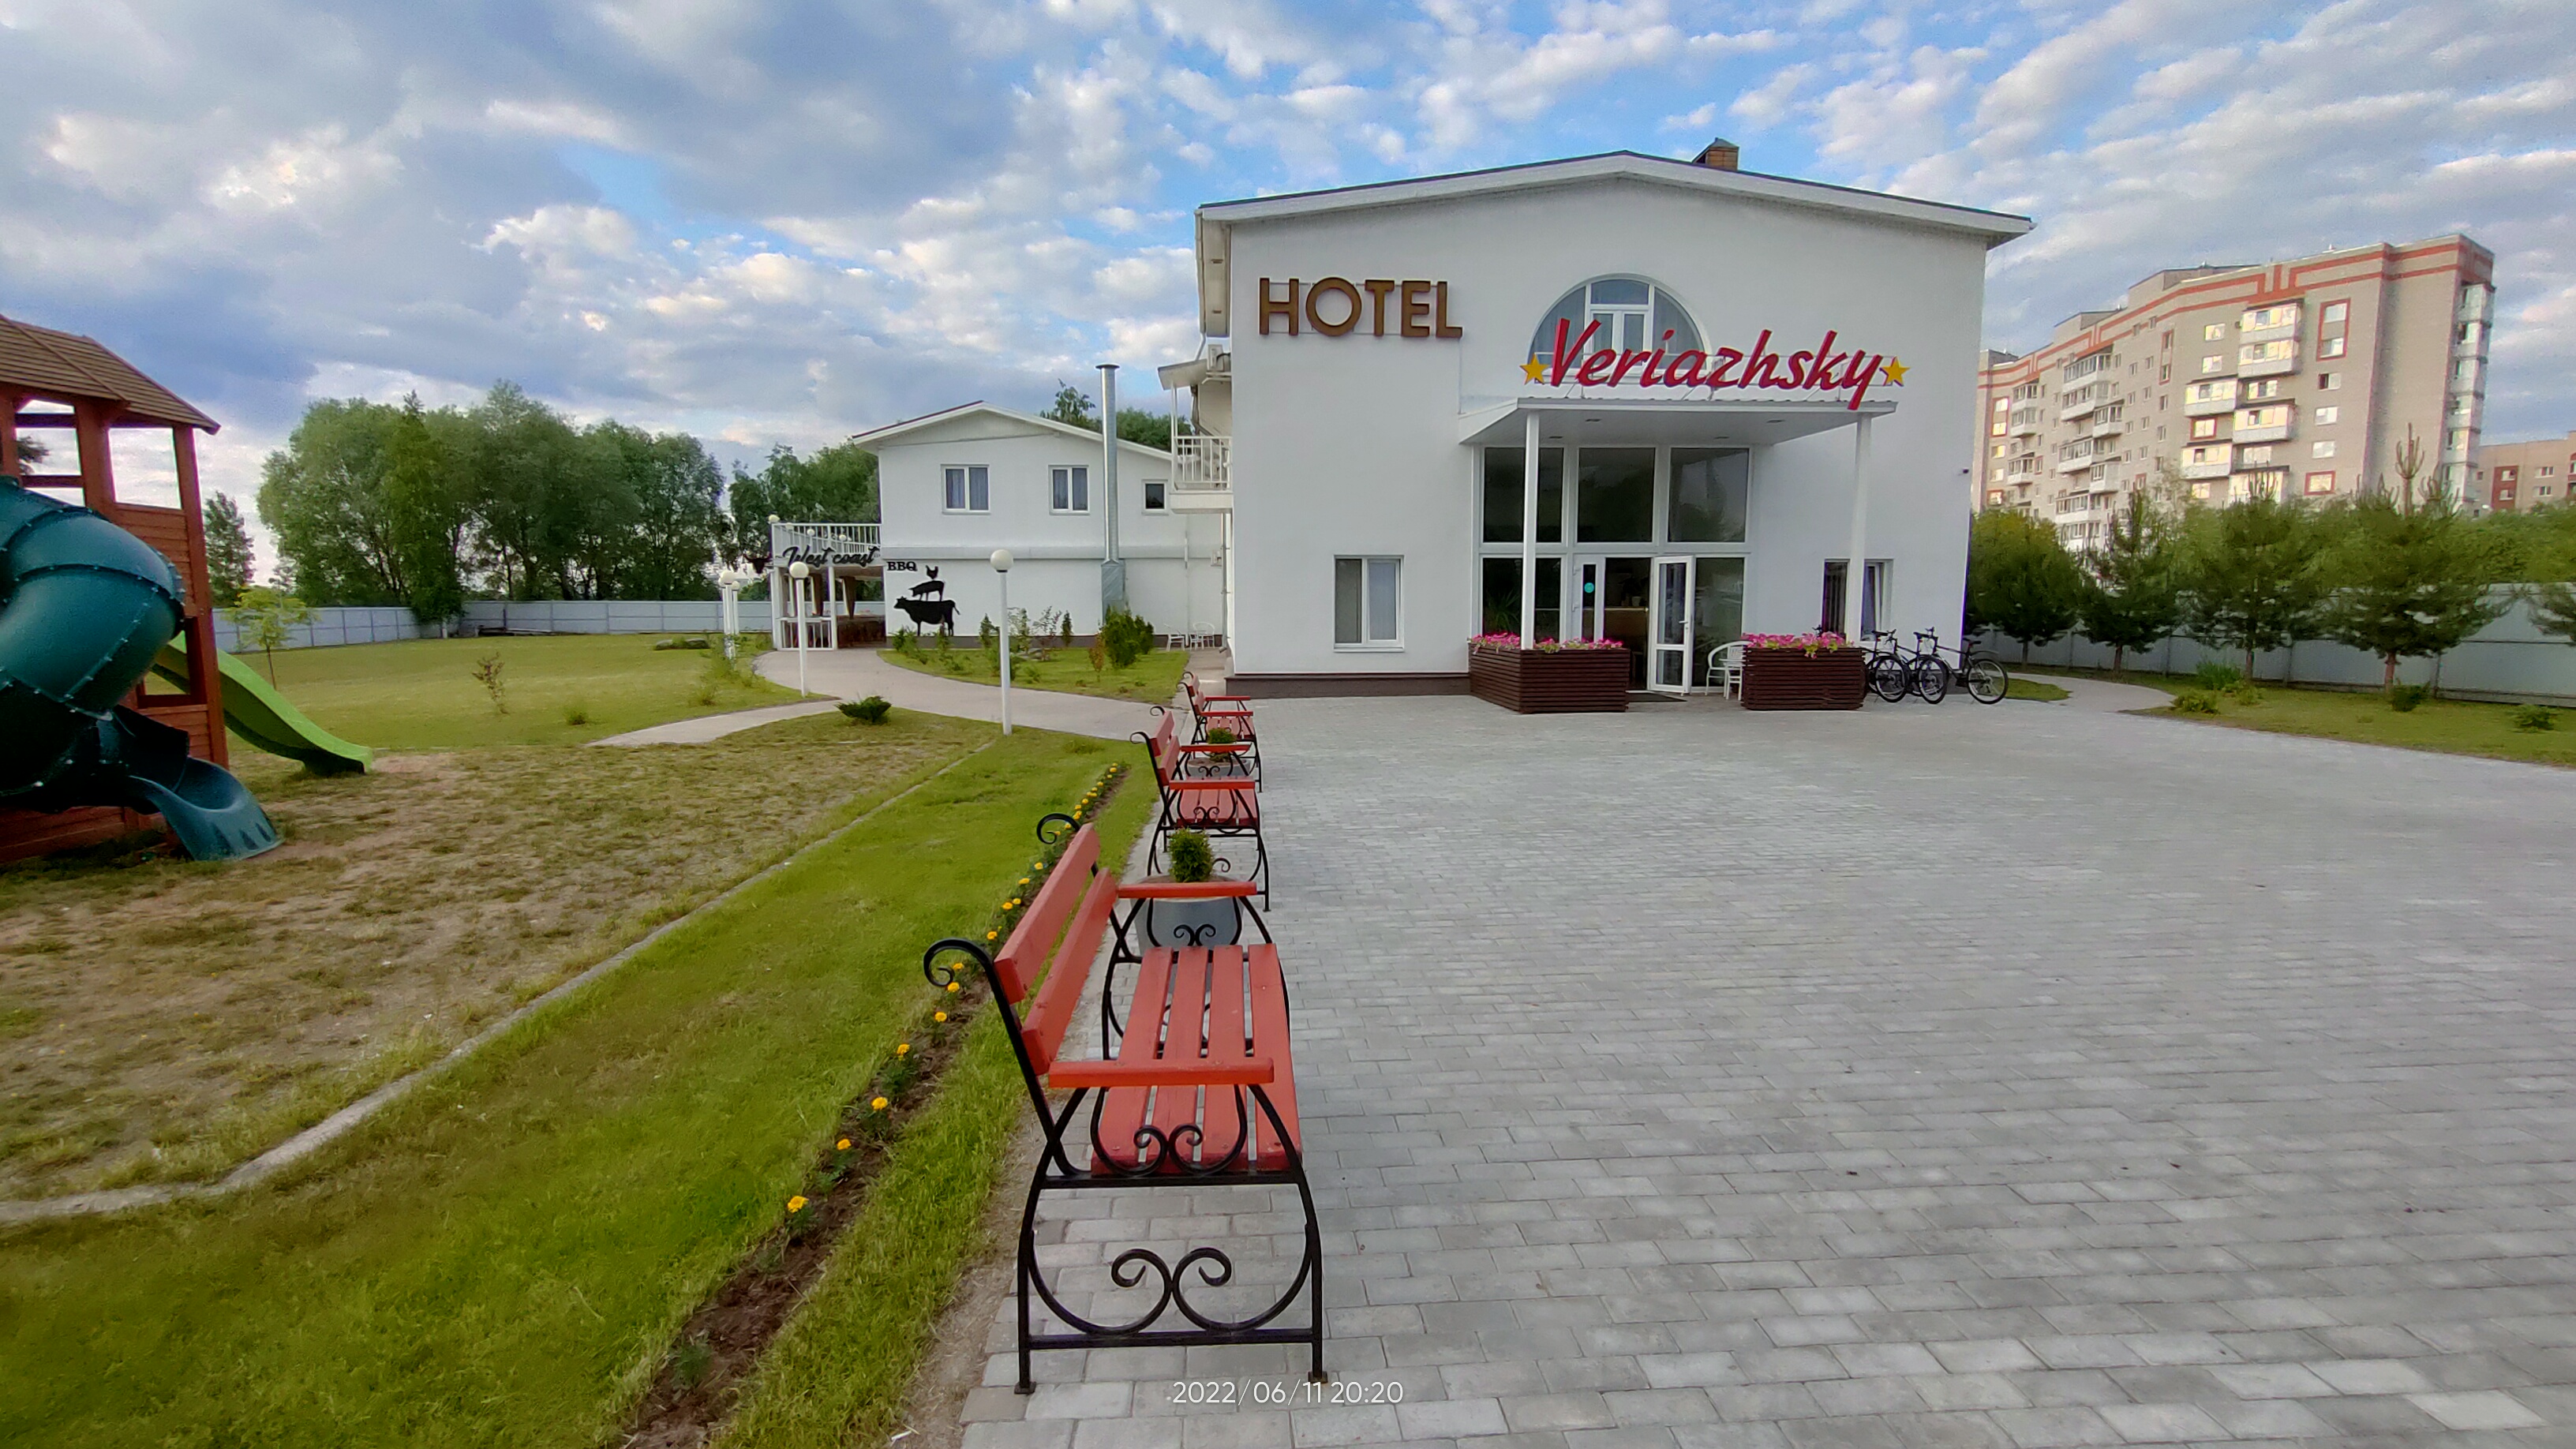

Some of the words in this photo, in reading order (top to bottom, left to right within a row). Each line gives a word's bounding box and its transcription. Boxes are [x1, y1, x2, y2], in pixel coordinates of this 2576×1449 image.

[1259, 276, 1462, 339] HOTEL
[1551, 318, 1883, 409] Veriazhsky
[782, 545, 836, 568] West
[833, 546, 880, 567] coast
[887, 561, 918, 572] BBQ
